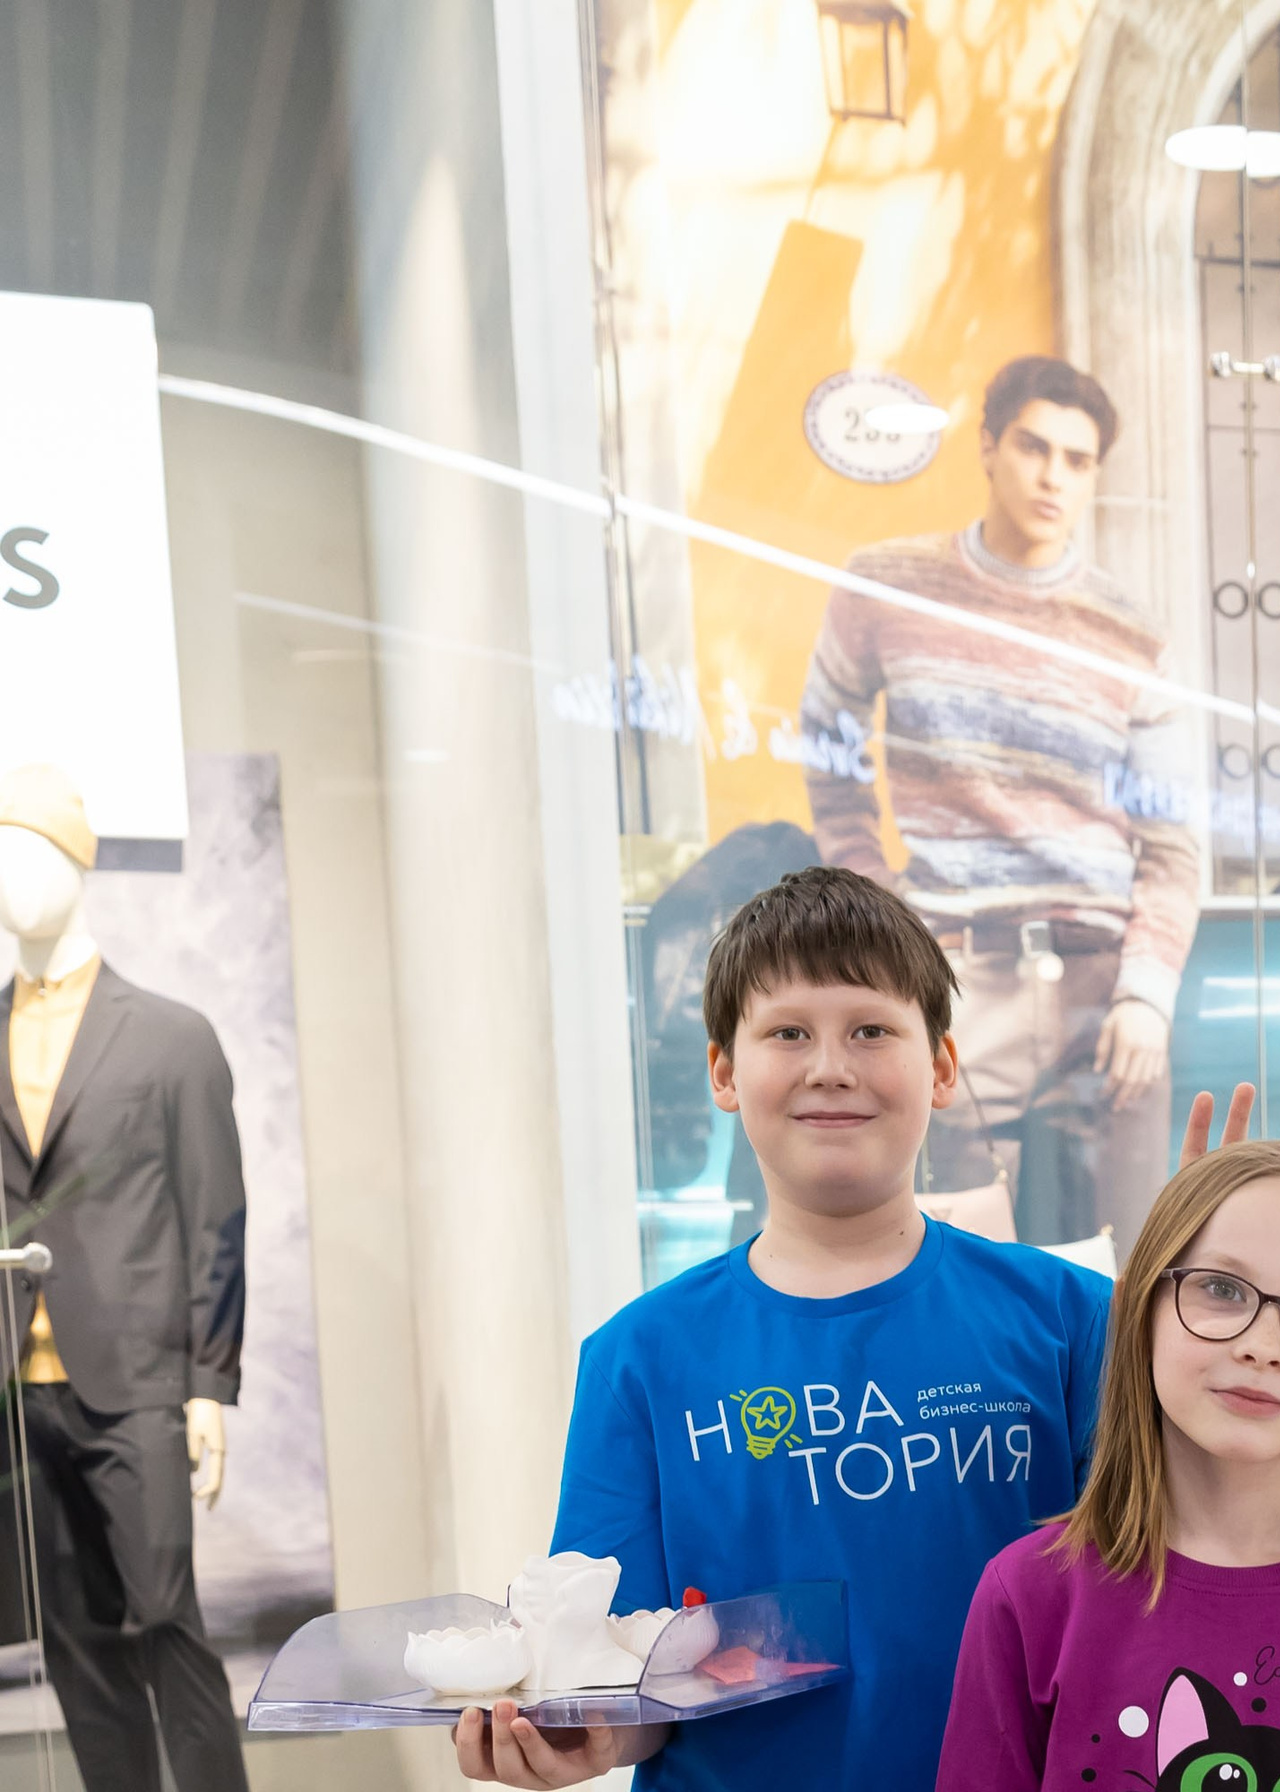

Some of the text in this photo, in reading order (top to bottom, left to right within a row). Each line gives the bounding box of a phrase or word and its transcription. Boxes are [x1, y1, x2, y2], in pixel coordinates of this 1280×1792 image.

[917, 1382, 982, 1403] детская
[919, 1401, 1032, 1420] бизнес-школа
[788, 1424, 1032, 1506] ТОРИЯ
